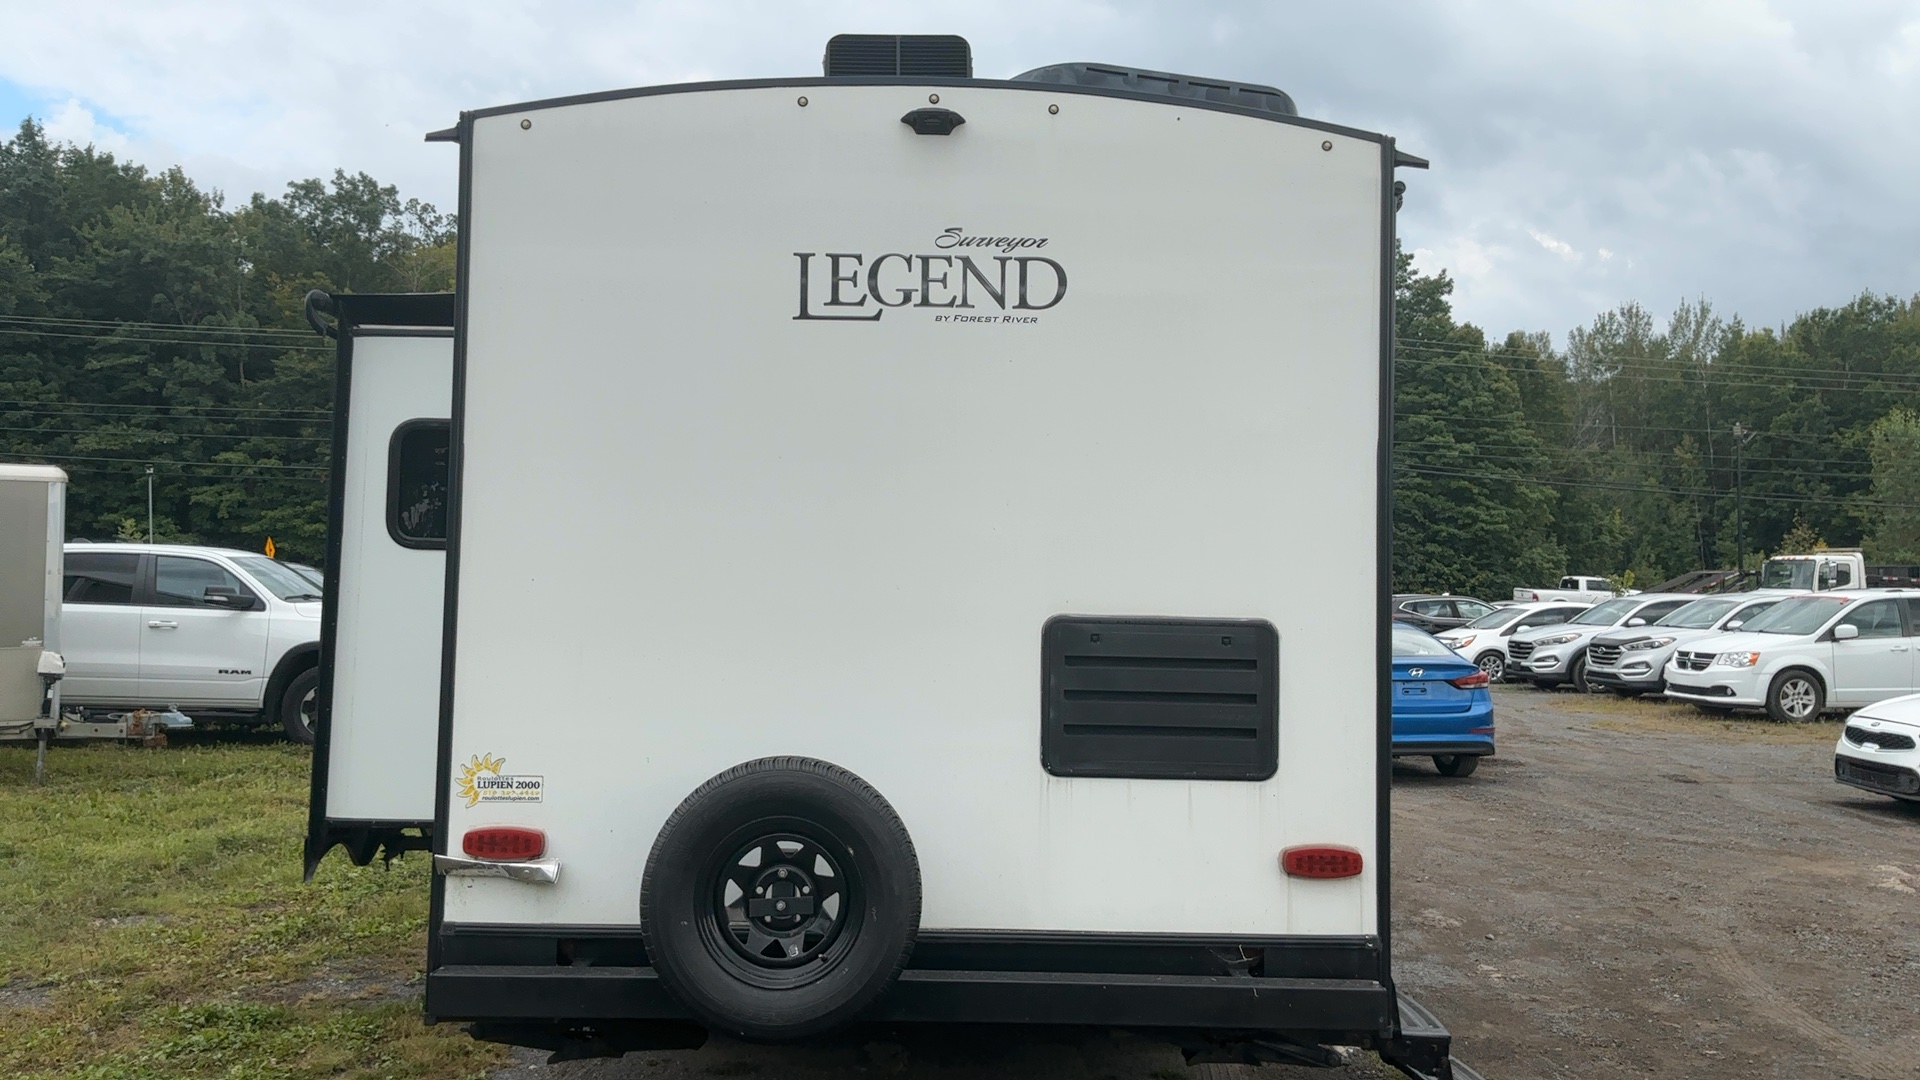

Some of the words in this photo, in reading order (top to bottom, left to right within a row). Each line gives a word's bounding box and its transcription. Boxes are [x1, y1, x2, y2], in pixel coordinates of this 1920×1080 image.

[934, 227, 1048, 253] Surveyor
[792, 252, 1067, 321] LEGEND
[953, 315, 999, 323] FOREST
[1002, 315, 1038, 324] RIVER
[477, 781, 513, 789] LUPIEN
[515, 781, 540, 789] 2000
